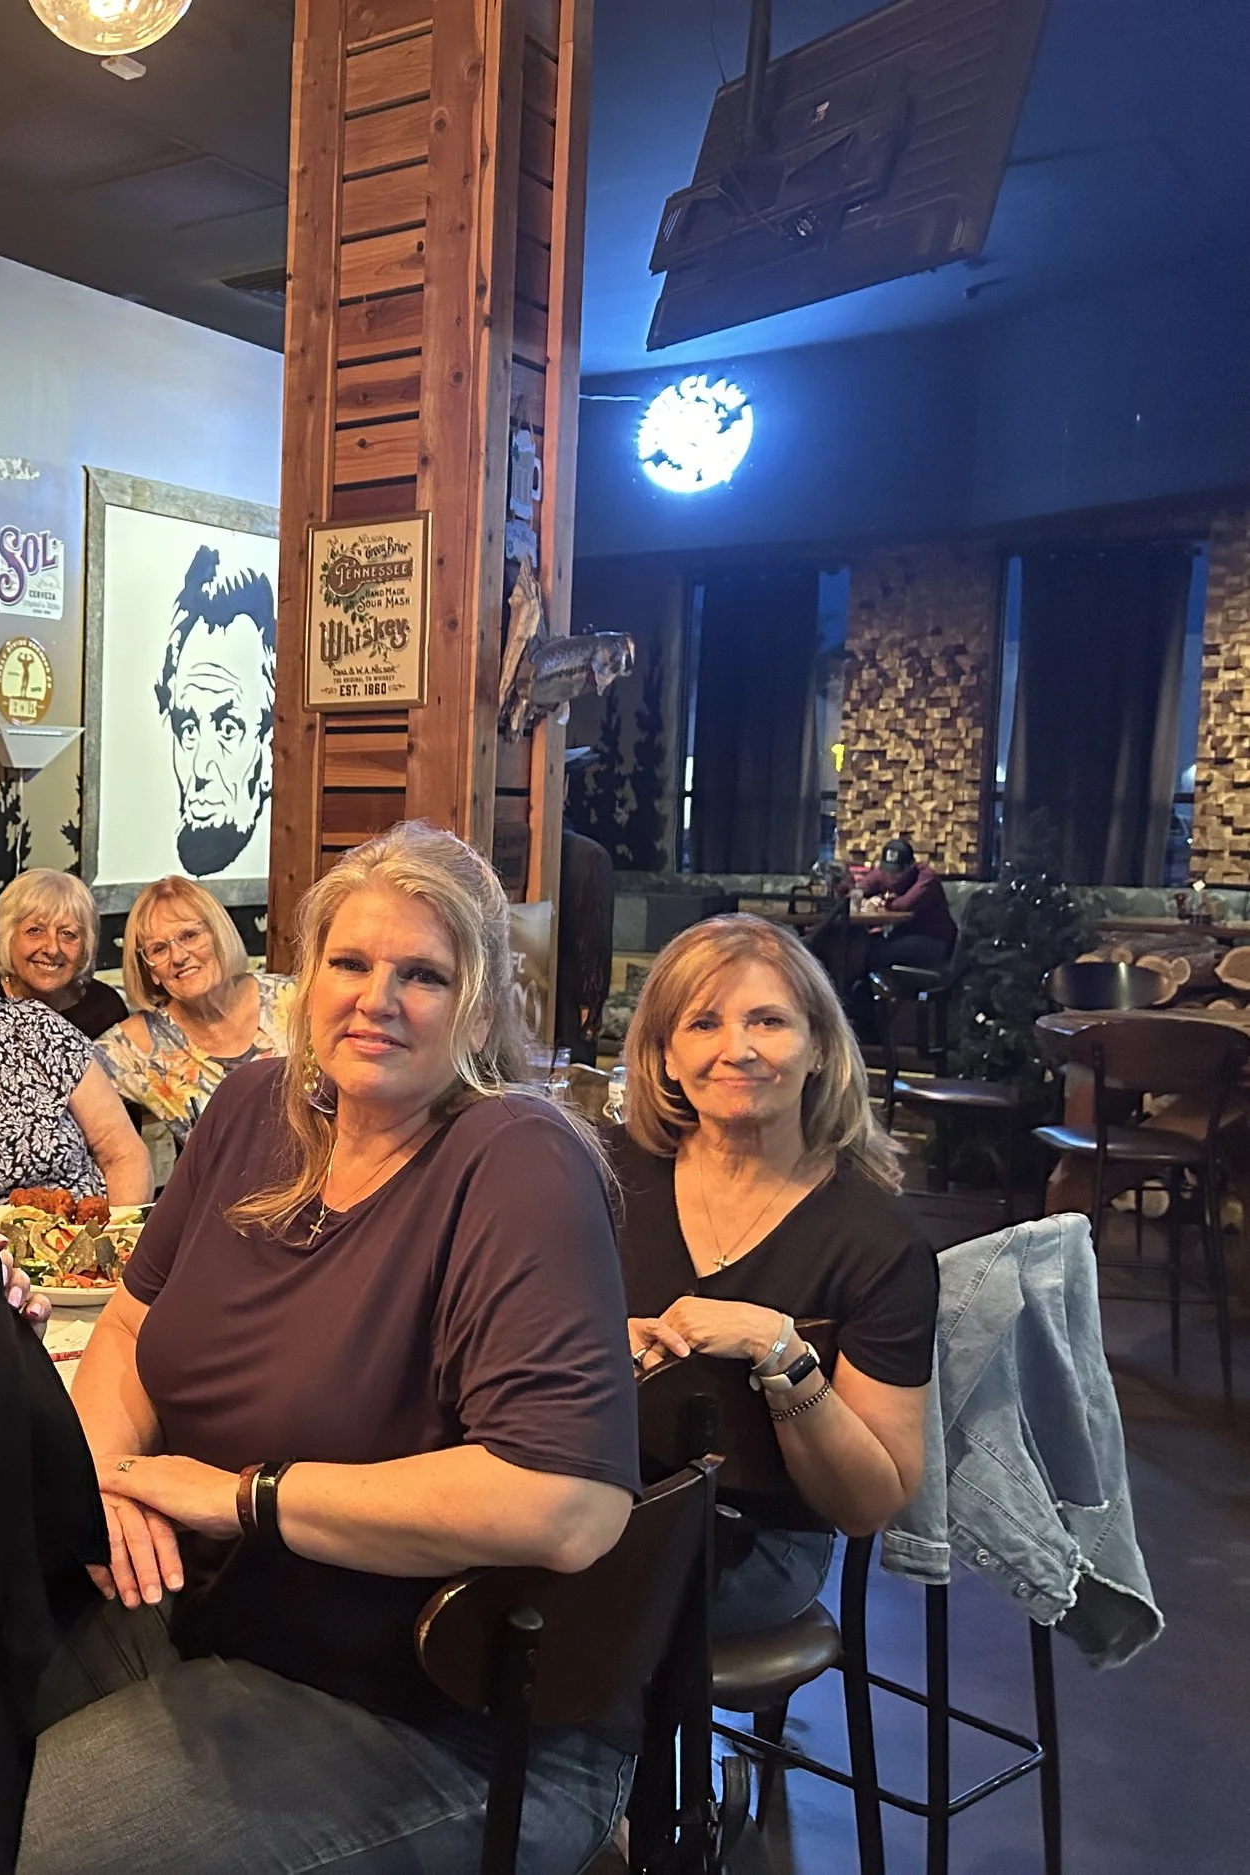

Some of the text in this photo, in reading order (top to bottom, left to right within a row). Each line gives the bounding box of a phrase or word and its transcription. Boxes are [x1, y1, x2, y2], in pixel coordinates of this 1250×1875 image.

[335, 563, 408, 588] TENNESSEE
[365, 587, 405, 598] HAND MADE
[357, 596, 410, 613] SOUR MASH
[339, 684, 361, 696] EST.
